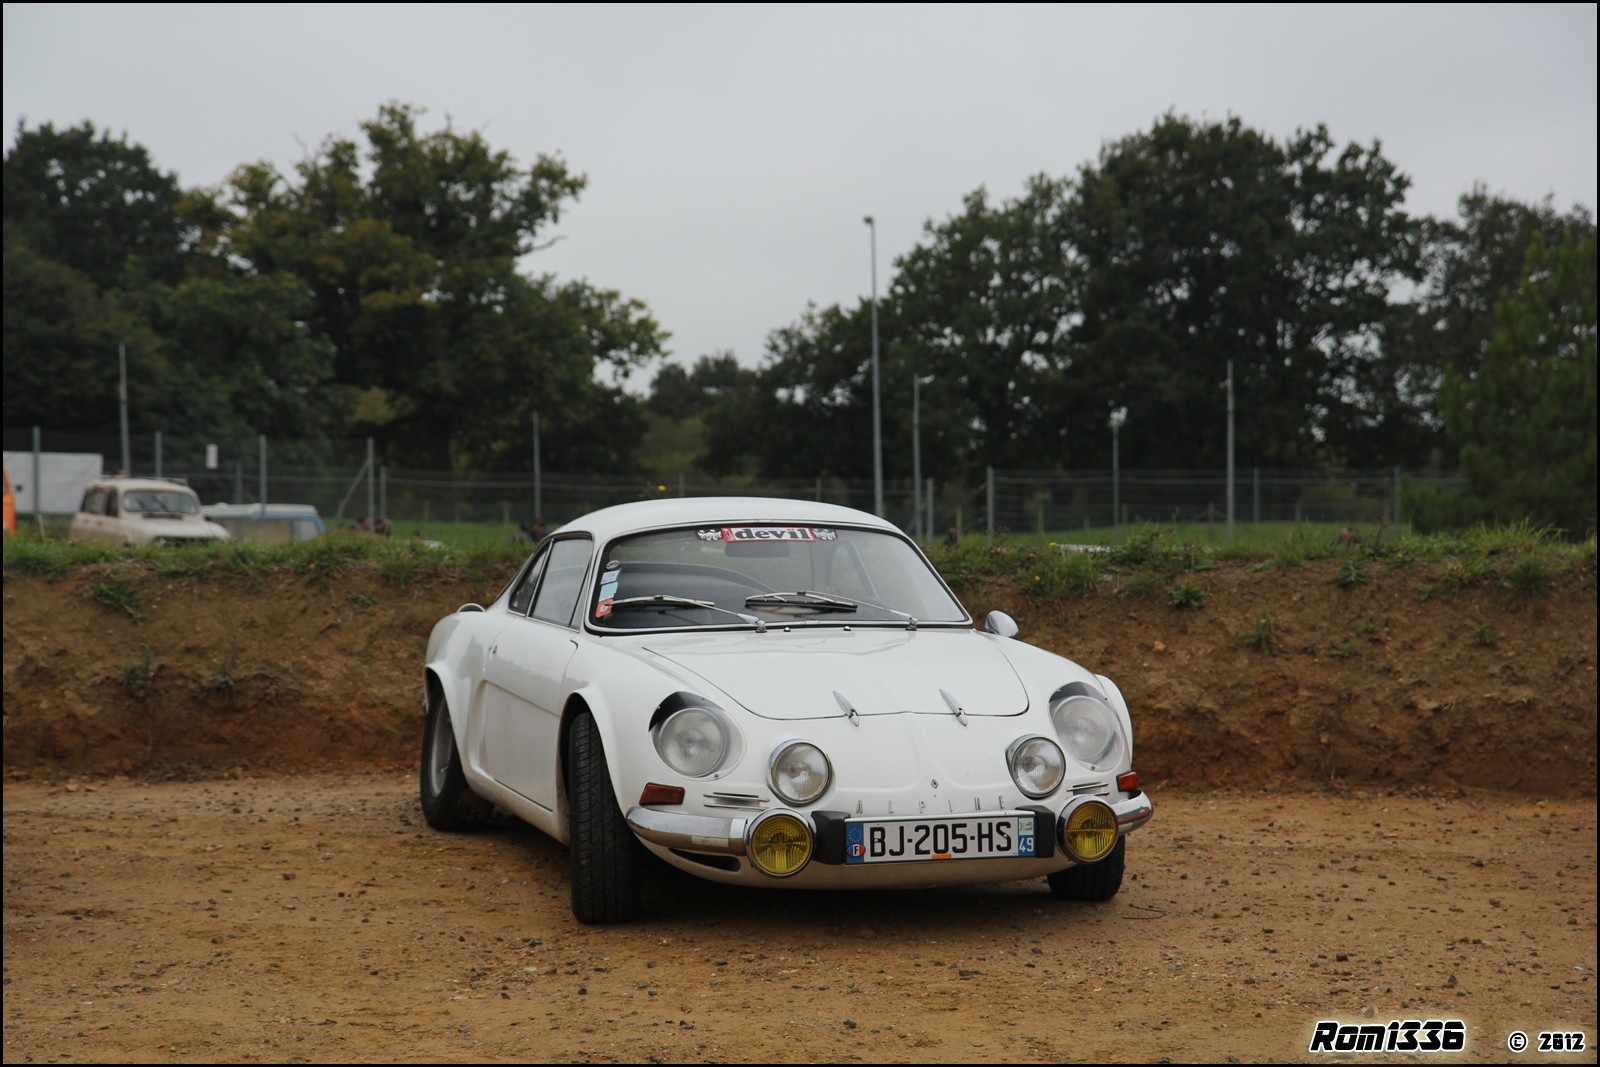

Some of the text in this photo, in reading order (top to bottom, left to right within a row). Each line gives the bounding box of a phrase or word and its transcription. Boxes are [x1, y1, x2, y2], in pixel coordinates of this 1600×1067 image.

[735, 528, 811, 540] devil
[856, 797, 1005, 813] ALPINE
[870, 822, 1012, 856] BJ-205-HS
[1019, 838, 1034, 852] 49
